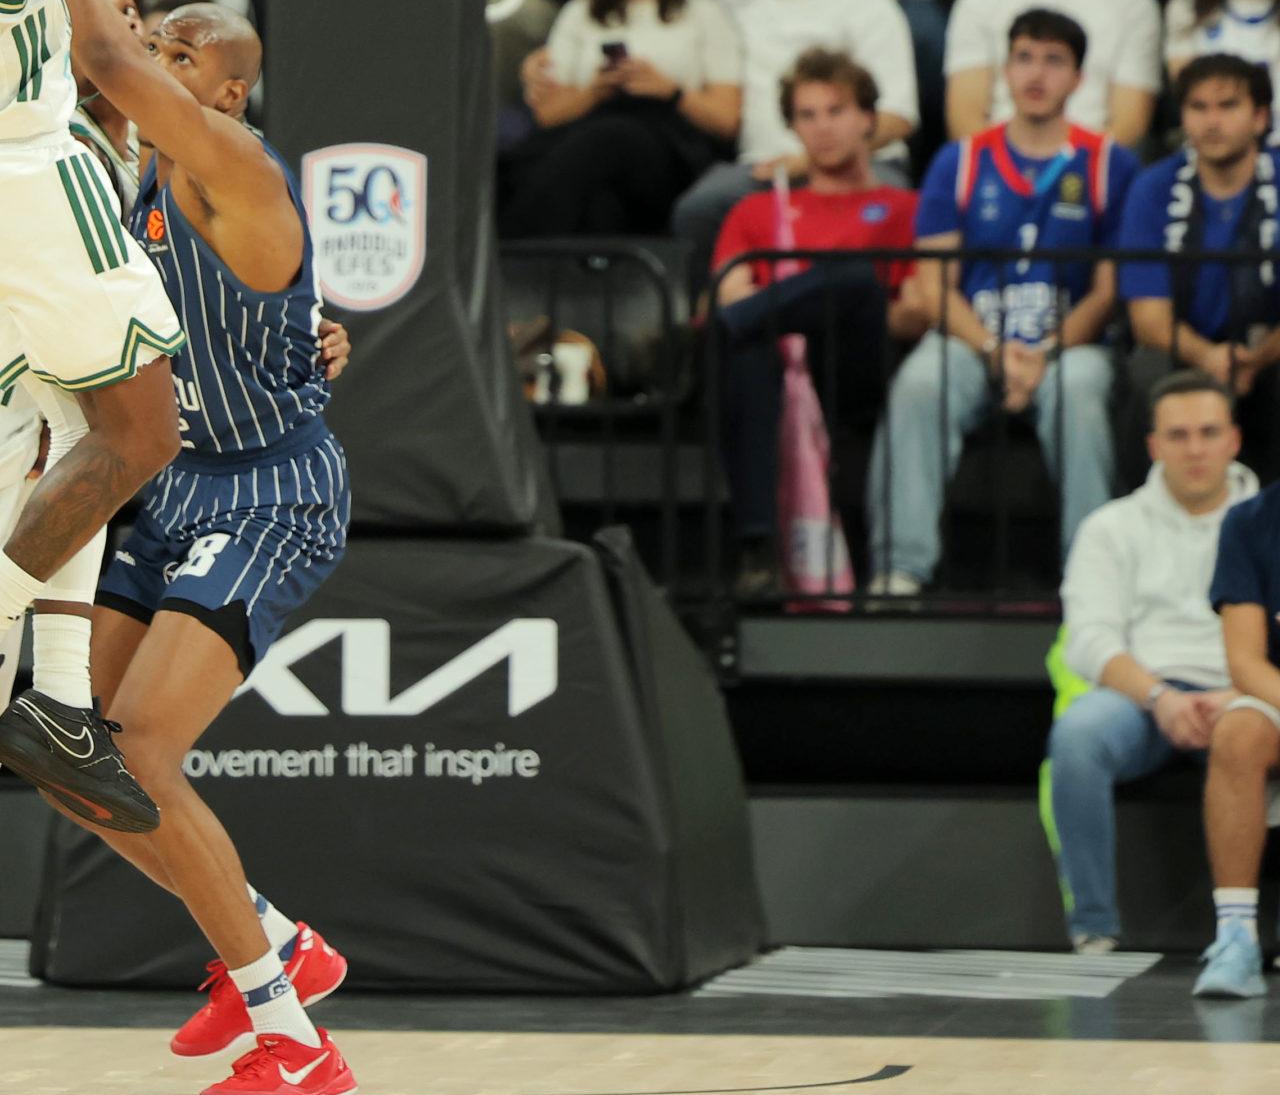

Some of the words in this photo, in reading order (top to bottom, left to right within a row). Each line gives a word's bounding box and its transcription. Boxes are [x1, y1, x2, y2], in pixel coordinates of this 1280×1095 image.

[334, 255, 396, 276] EFES
[182, 744, 338, 778] ovement
[344, 742, 418, 778] that
[424, 742, 540, 785] inspire
